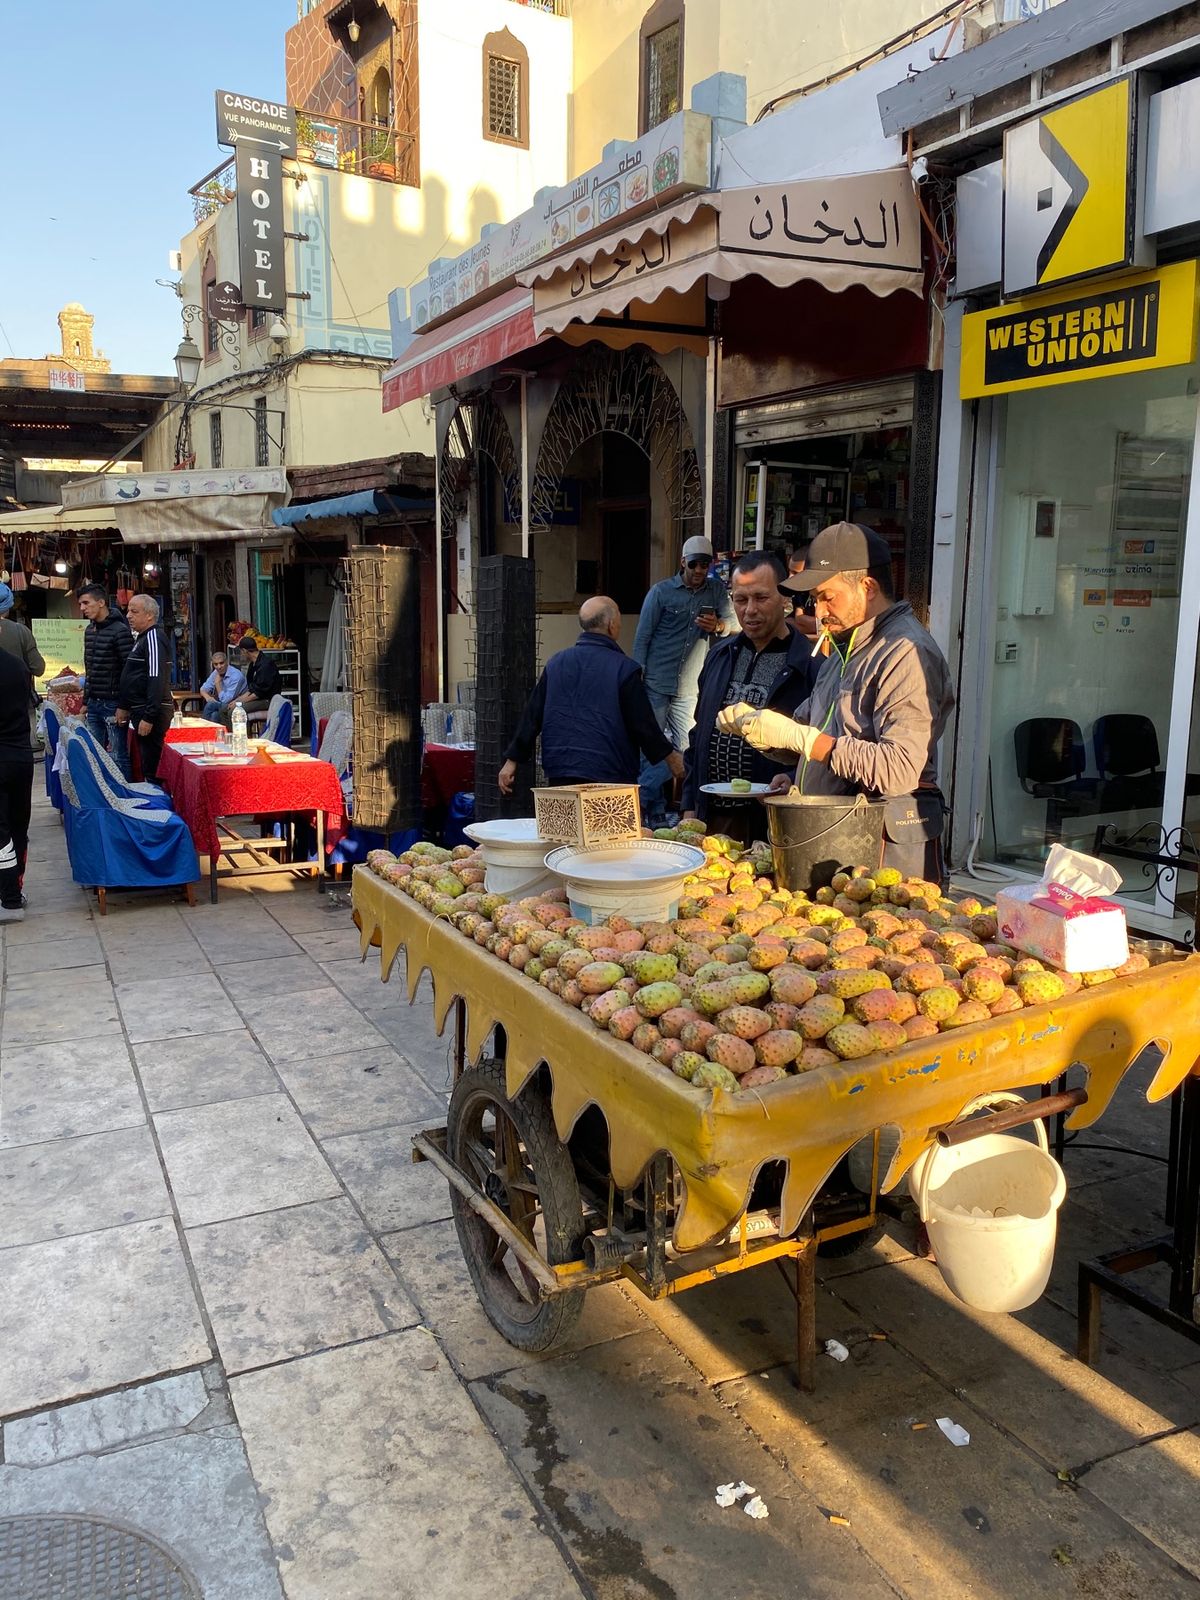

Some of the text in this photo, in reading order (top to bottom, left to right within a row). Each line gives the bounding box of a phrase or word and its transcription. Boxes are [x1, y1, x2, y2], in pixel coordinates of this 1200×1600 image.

[224, 94, 288, 120] CASCADE
[224, 112, 292, 135] VUE PANORAMIQUE
[249, 157, 273, 300] HOTEL
[749, 194, 900, 249] الدخان
[429, 265, 458, 291] Restaurant
[988, 299, 1126, 351] WESTERN
[1026, 326, 1125, 368] UNION
